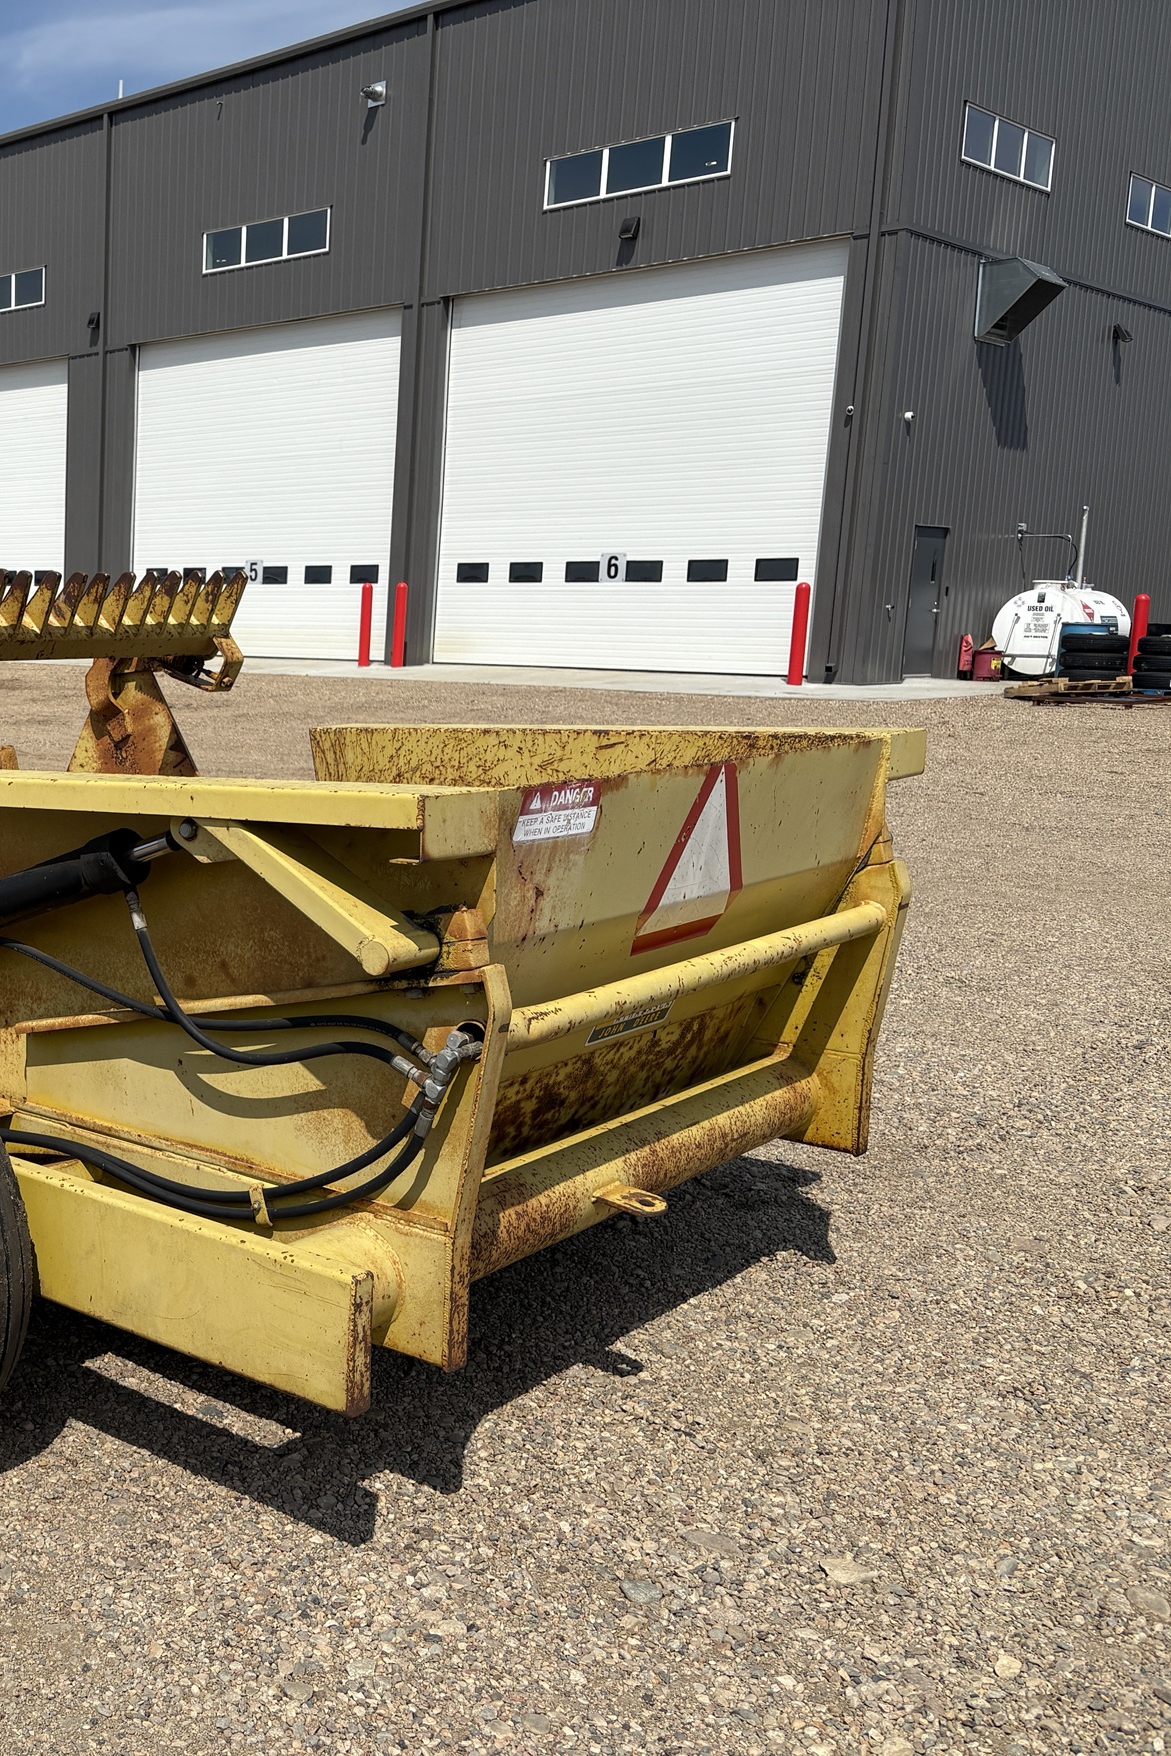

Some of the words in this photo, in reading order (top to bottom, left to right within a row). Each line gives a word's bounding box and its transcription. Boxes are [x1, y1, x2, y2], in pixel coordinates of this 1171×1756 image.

[250, 563, 258, 581] 5
[607, 556, 619, 579] 6
[550, 787, 594, 806] DANGER
[521, 818, 539, 827] KEEP
[539, 817, 544, 825] A
[546, 813, 561, 824] SAFE
[562, 810, 592, 822] DISTANCE
[523, 828, 542, 837] WHEN
[543, 826, 550, 835] IN
[552, 822, 586, 834] OPERATION
[598, 1023, 626, 1039] JOHN
[632, 1011, 661, 1027] DEERE
